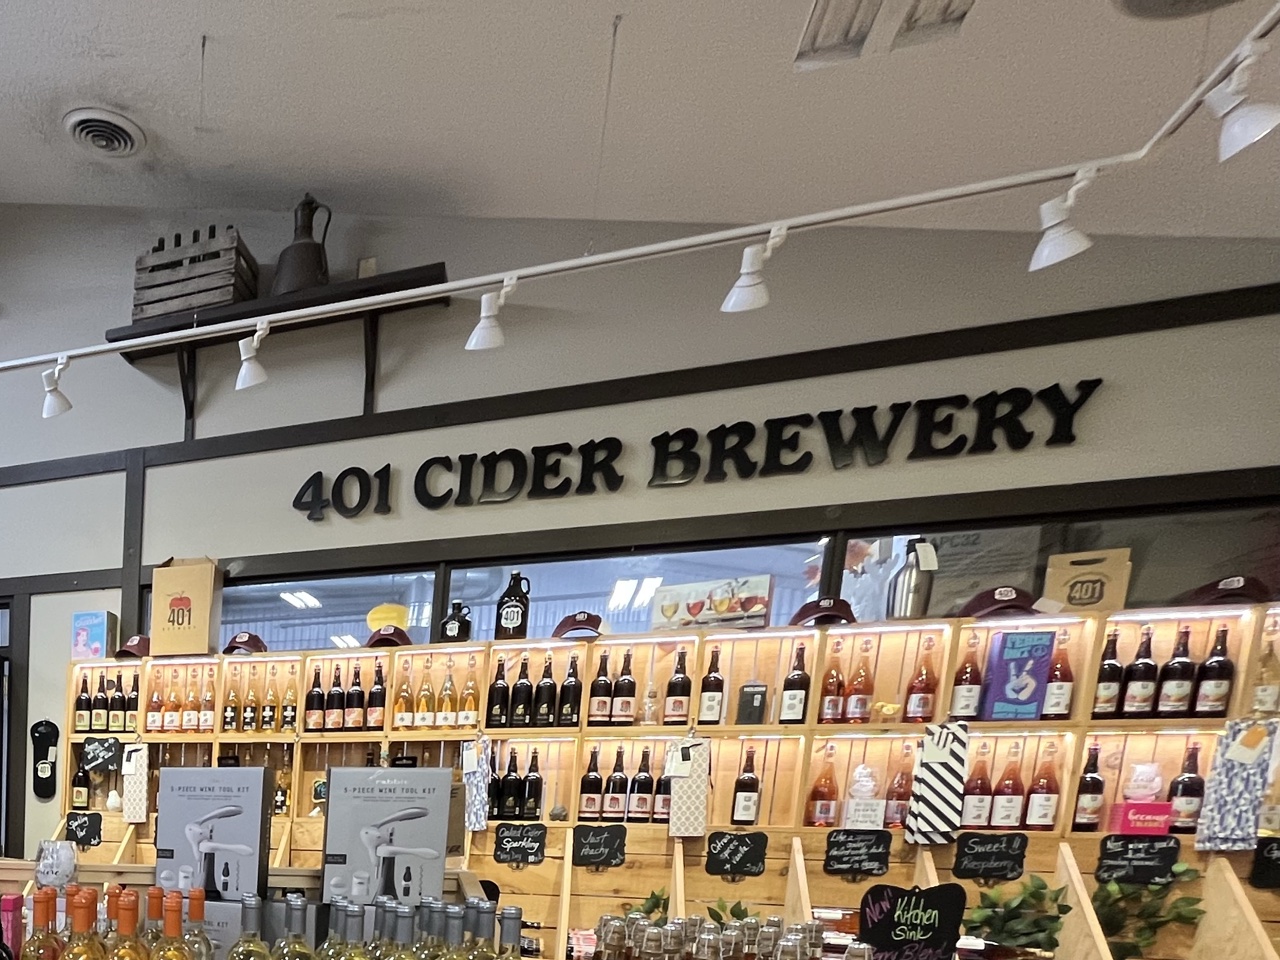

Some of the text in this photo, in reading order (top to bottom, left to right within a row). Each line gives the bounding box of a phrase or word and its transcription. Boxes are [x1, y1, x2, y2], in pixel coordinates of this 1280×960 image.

[293, 378, 1104, 521] 401 CIDER BREWERY
[1070, 581, 1101, 599] 401
[168, 608, 192, 627] 401
[504, 610, 520, 622] 401
[501, 837, 540, 852] Sparkling
[894, 895, 939, 928] Kitchen
[891, 925, 933, 941] Sink
